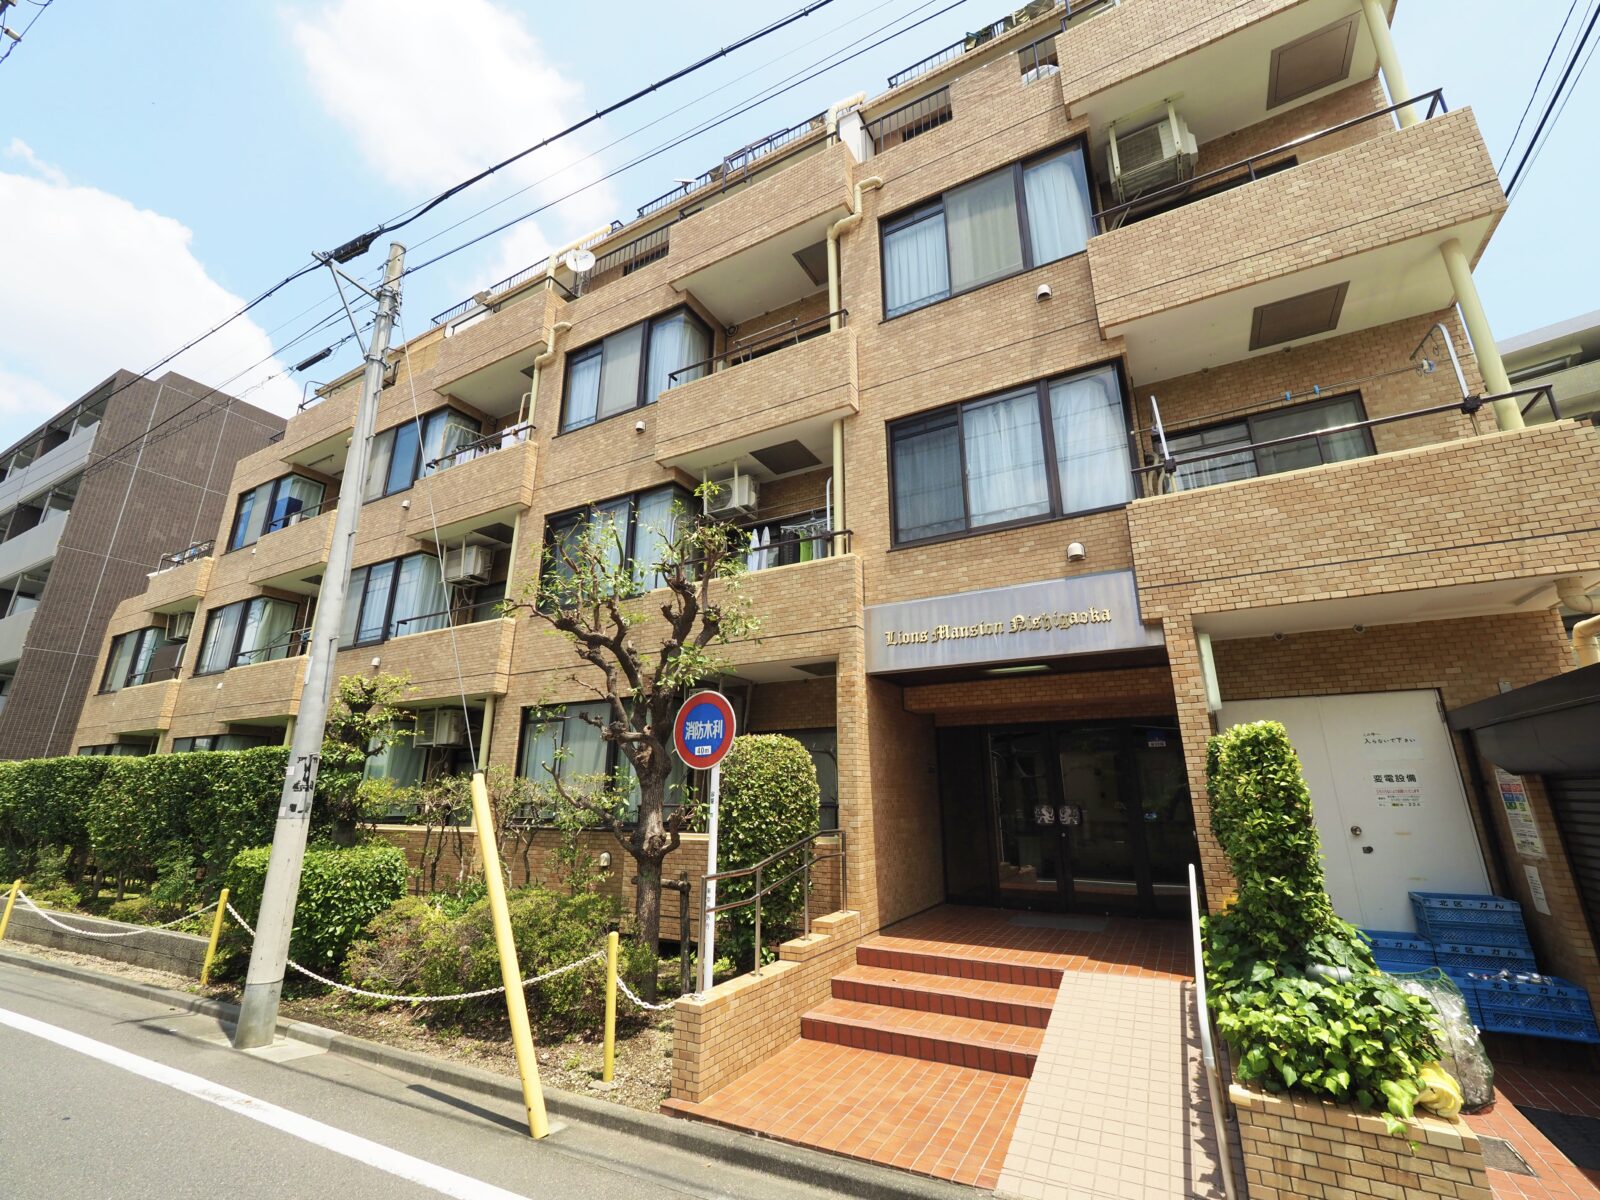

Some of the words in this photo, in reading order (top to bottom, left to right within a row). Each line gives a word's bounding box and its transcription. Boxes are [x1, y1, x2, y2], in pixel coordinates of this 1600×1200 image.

[885, 630, 929, 647] Lions
[932, 621, 1005, 643] Mansion
[685, 719, 723, 741] 消防水利
[1373, 773, 1417, 783] 変電設備
